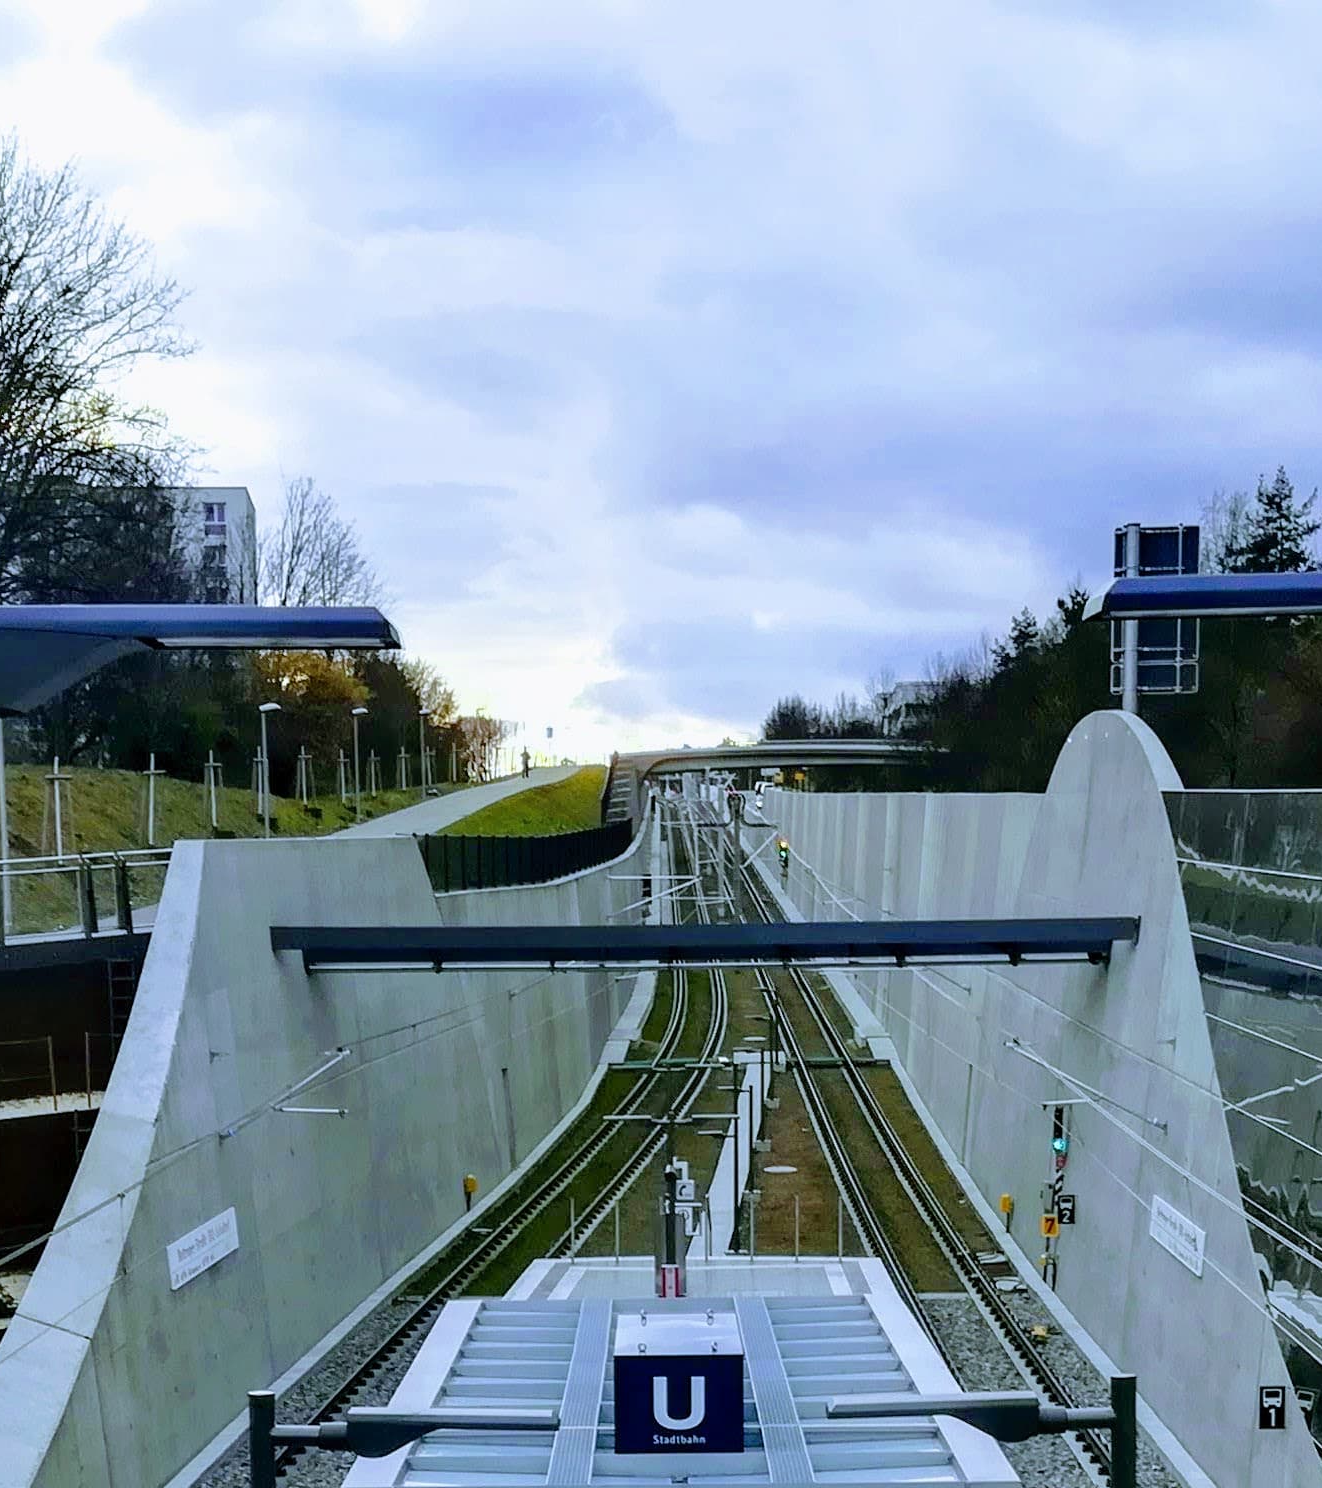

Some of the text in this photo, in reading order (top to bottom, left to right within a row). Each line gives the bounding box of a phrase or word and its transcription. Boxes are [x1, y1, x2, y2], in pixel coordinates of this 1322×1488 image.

[1062, 1210, 1071, 1223] 2
[1044, 1217, 1055, 1234] 7
[653, 1376, 706, 1431] U
[1268, 1407, 1276, 1427] 1
[652, 1434, 706, 1445] Stadtbahn
